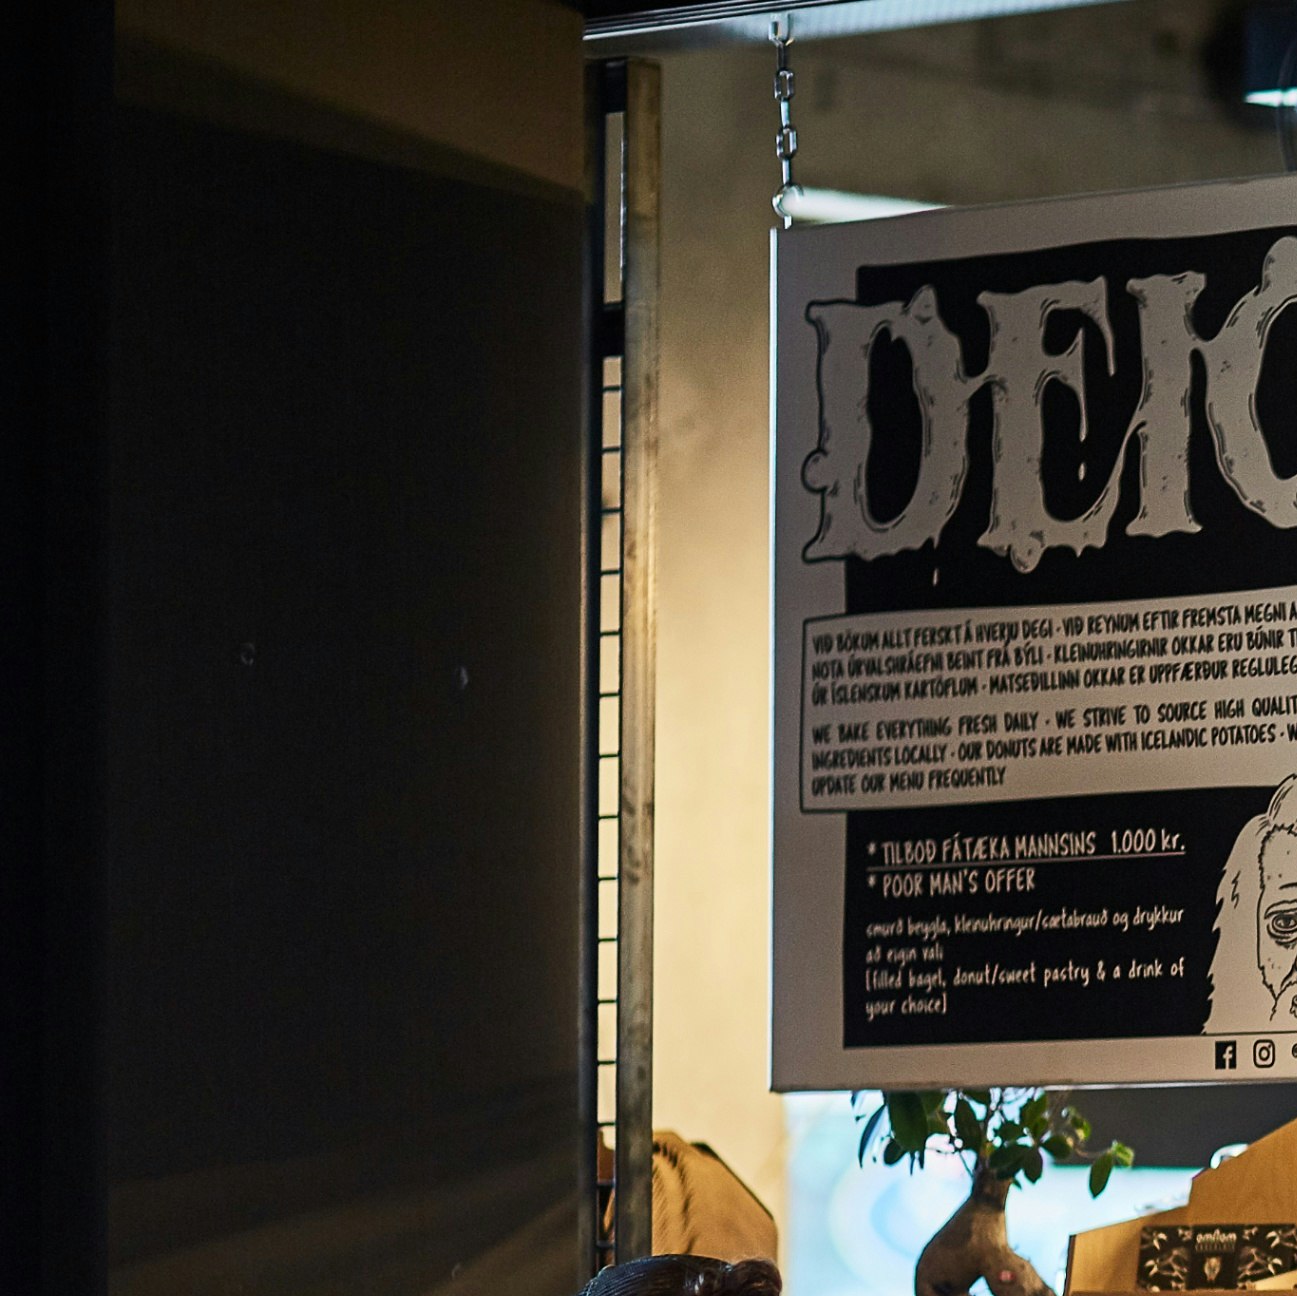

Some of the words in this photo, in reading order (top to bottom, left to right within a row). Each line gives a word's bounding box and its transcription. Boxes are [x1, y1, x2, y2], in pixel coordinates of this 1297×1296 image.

[883, 840, 936, 864] TILBOÐ
[1016, 832, 1095, 859] MANNSINS
[1112, 829, 1154, 854] 1.000
[1162, 829, 1186, 854] kr.
[884, 874, 922, 897] POOR
[930, 870, 978, 895] MAN'S
[985, 868, 1034, 892] OFFER
